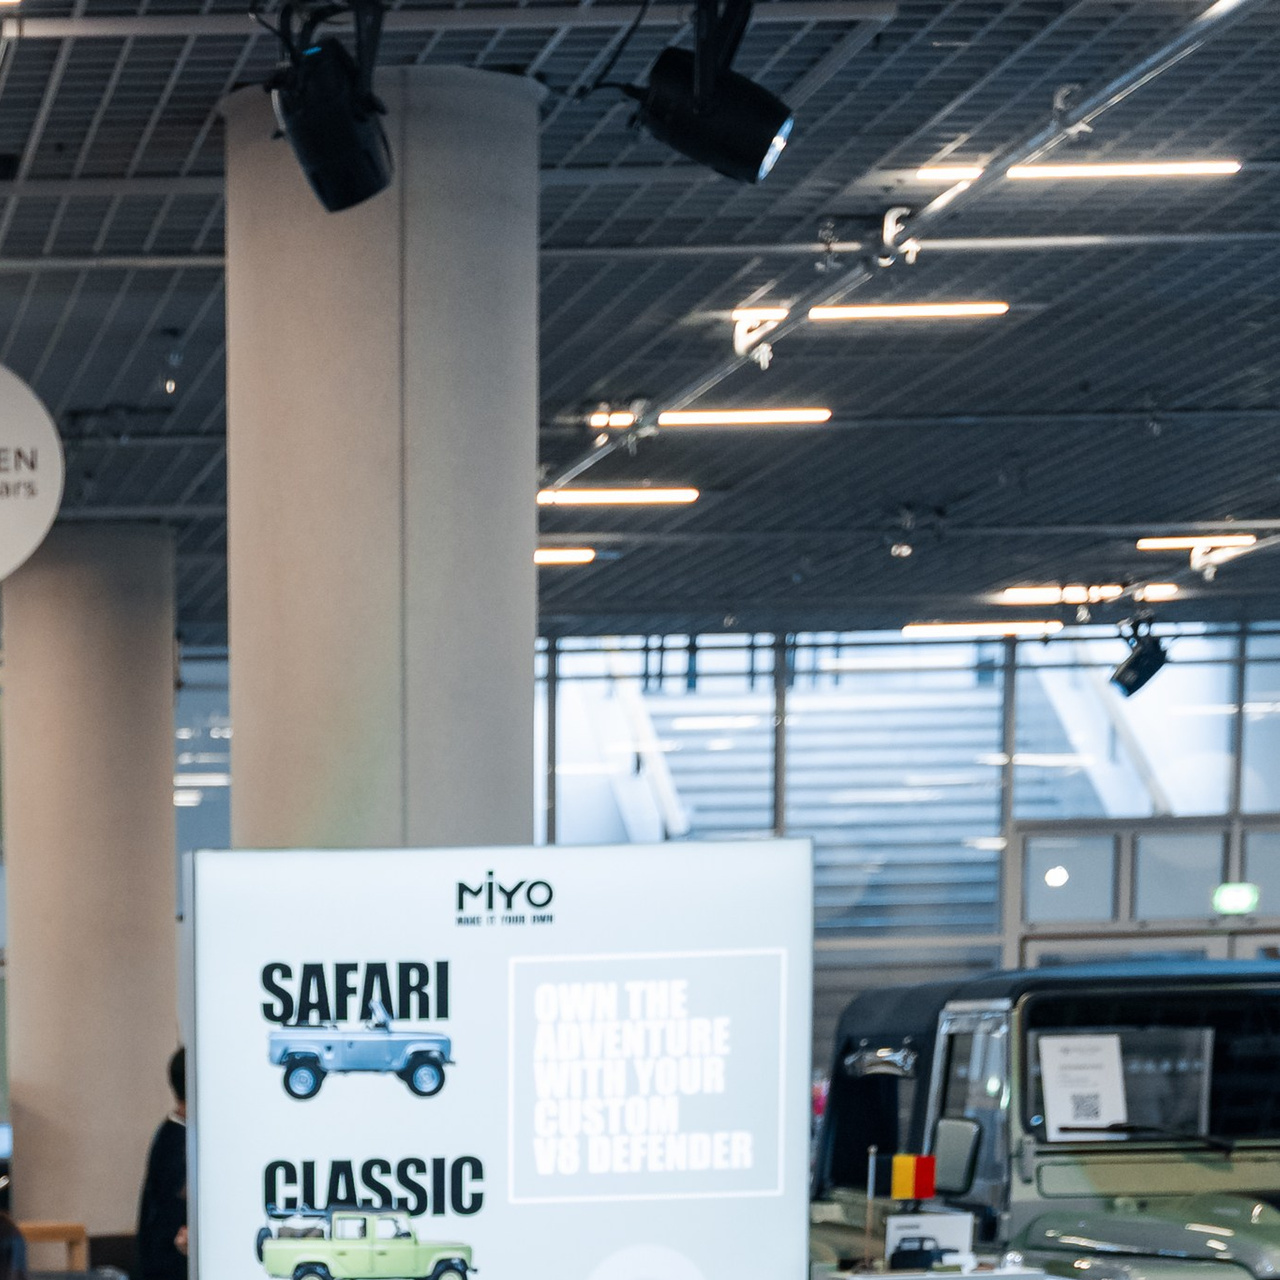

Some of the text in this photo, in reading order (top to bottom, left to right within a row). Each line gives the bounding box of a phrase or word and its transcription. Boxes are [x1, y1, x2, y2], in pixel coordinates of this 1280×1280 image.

[262, 961, 449, 1024] SAFARI
[535, 979, 688, 1023] OWN THE
[534, 1017, 731, 1061] ADVENTURE
[534, 1056, 725, 1100] WITH YOUR
[535, 1095, 679, 1137] CUSTOM
[534, 1130, 753, 1176] V8 DEFENDER
[265, 1156, 484, 1217] CLASSIC
